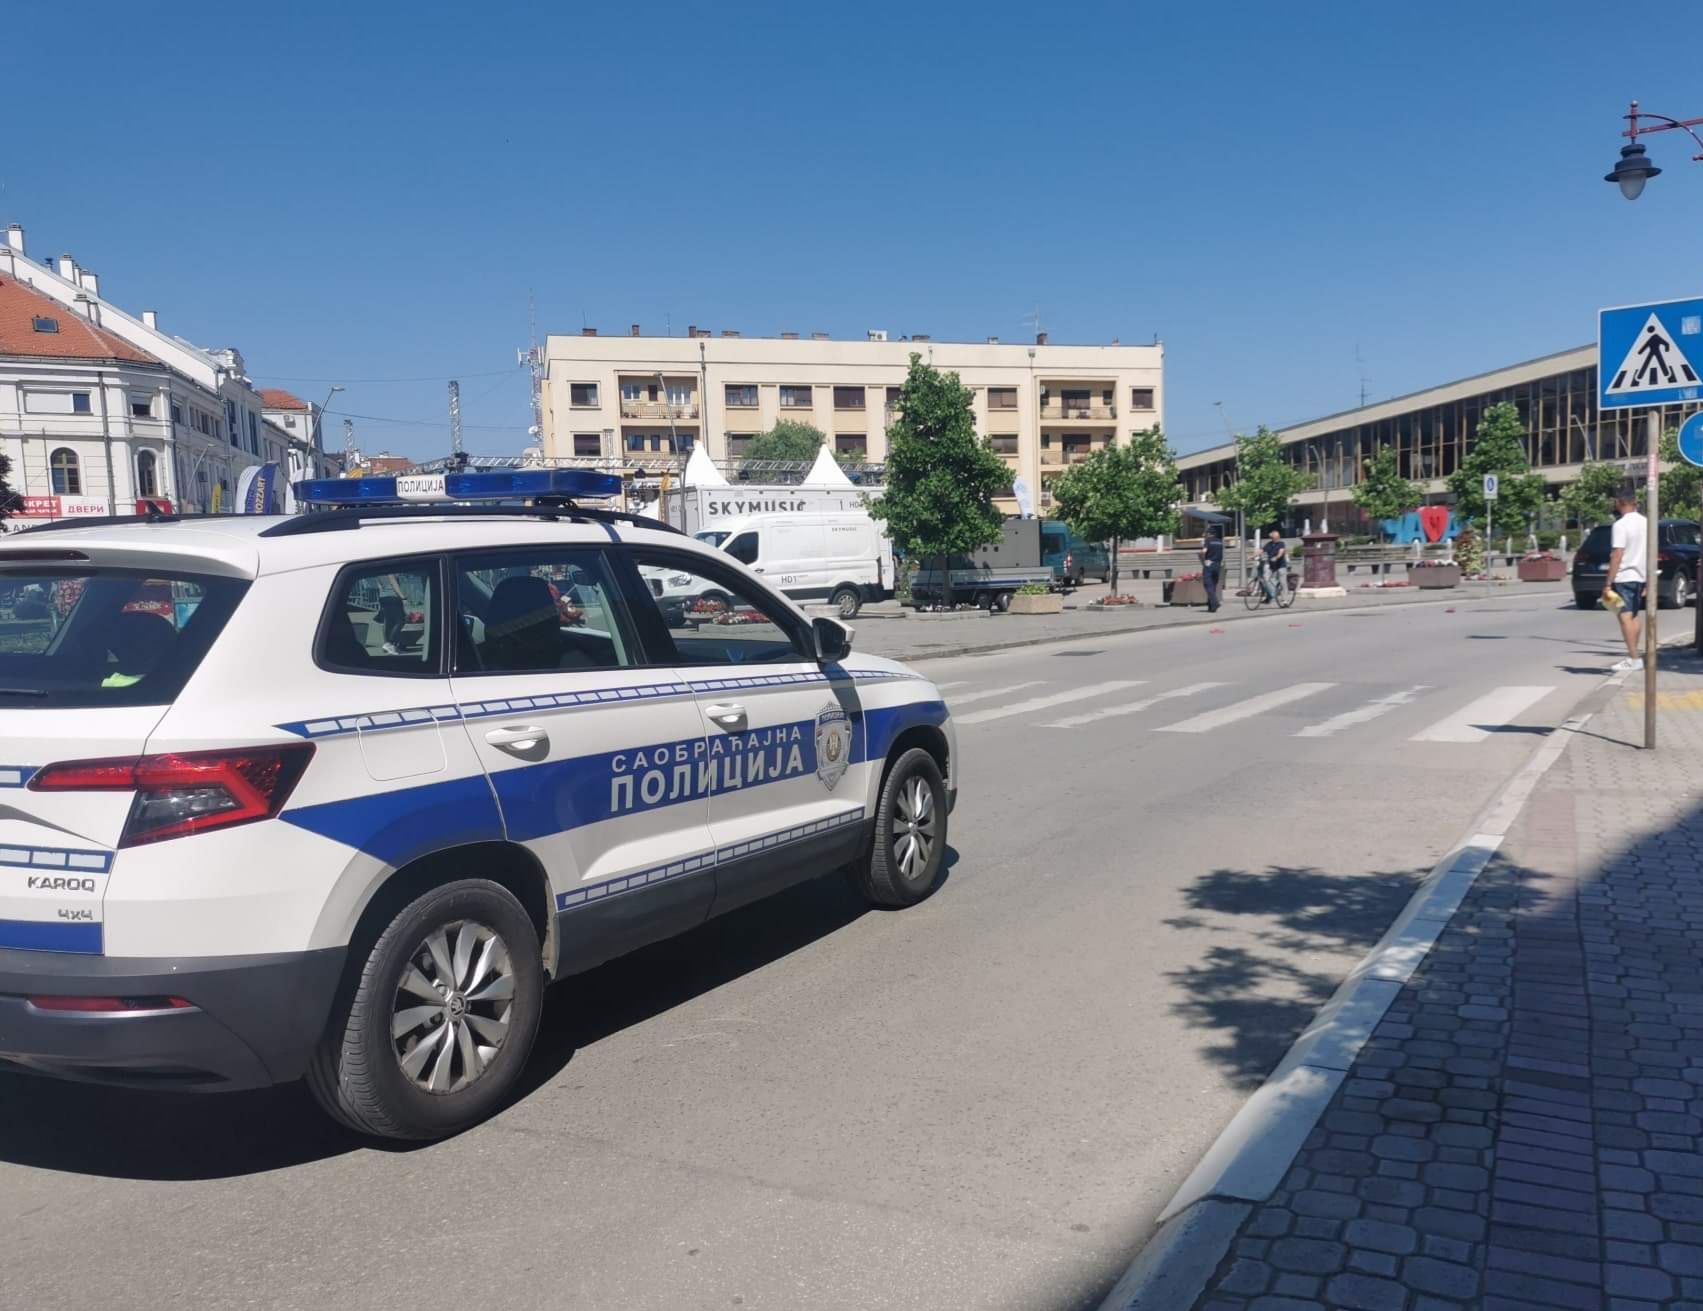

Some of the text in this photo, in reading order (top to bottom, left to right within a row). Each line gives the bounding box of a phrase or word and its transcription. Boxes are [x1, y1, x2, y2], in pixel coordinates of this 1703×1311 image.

[398, 479, 444, 493] ПОЛИЦИЈА
[67, 504, 104, 514] ДВЕРИ
[709, 500, 807, 515] SKYMUSIC
[781, 575, 797, 584] HD1
[611, 725, 802, 773] САОБРАЋАЈНА
[610, 744, 804, 812] ПОЛИЦИЈА
[27, 876, 95, 892] KAROQ
